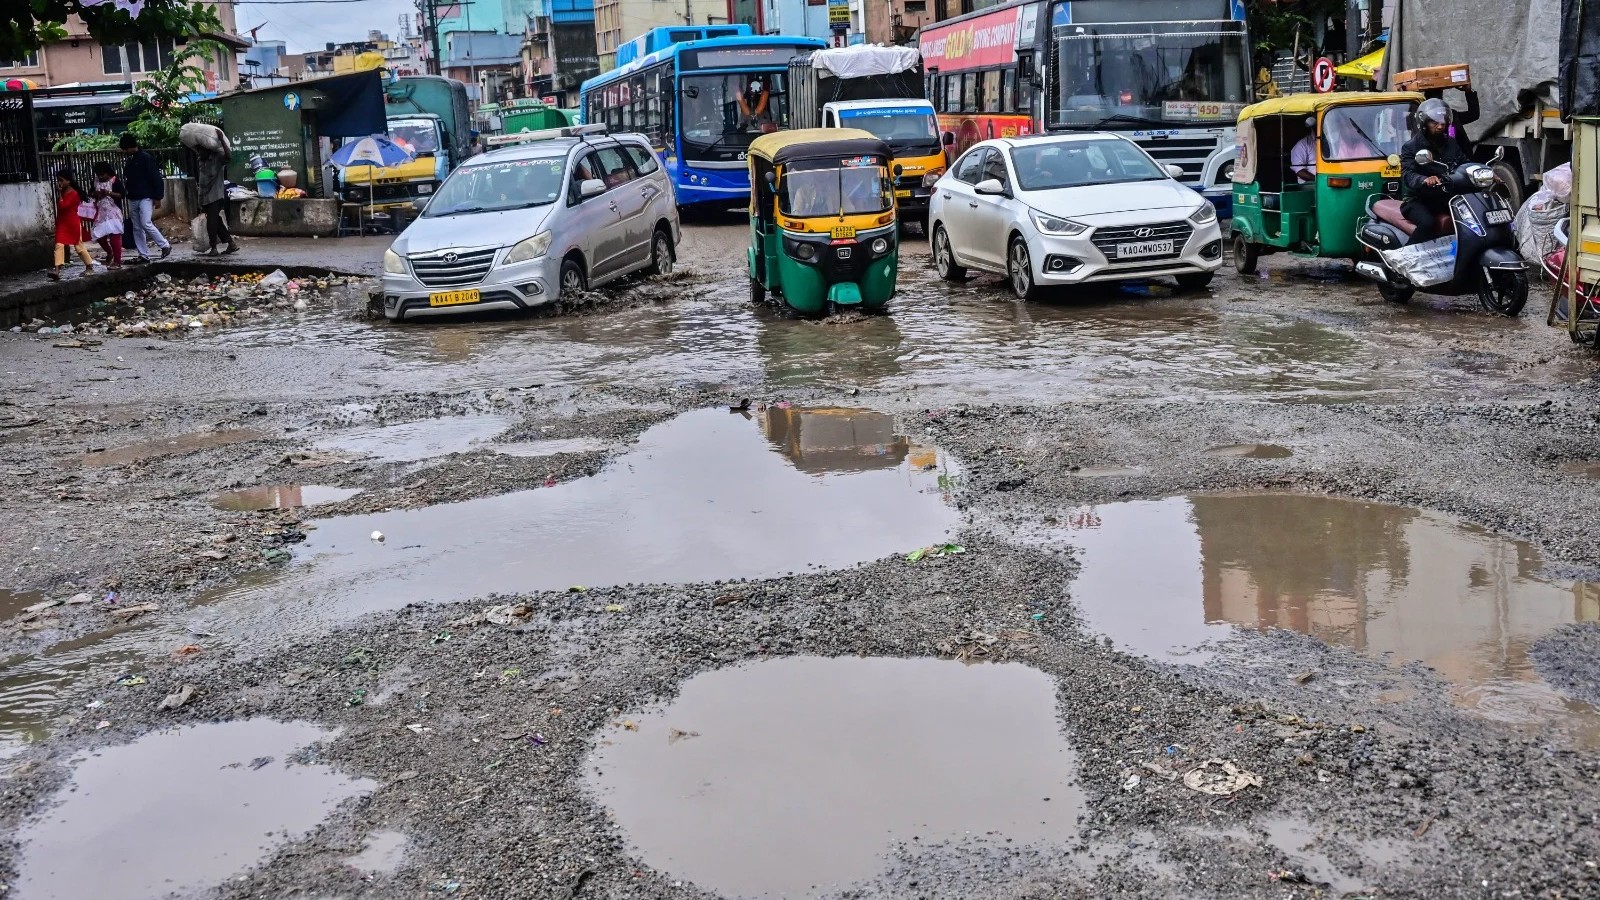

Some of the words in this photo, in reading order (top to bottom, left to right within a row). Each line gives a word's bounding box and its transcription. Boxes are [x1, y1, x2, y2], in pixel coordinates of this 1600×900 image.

[945, 30, 966, 60] GOLD
[990, 22, 1015, 47] COMPANY
[1319, 64, 1329, 88] P
[1200, 105, 1219, 115] 45D
[1122, 242, 1172, 255] KA04MW0537
[454, 293, 460, 301] B
